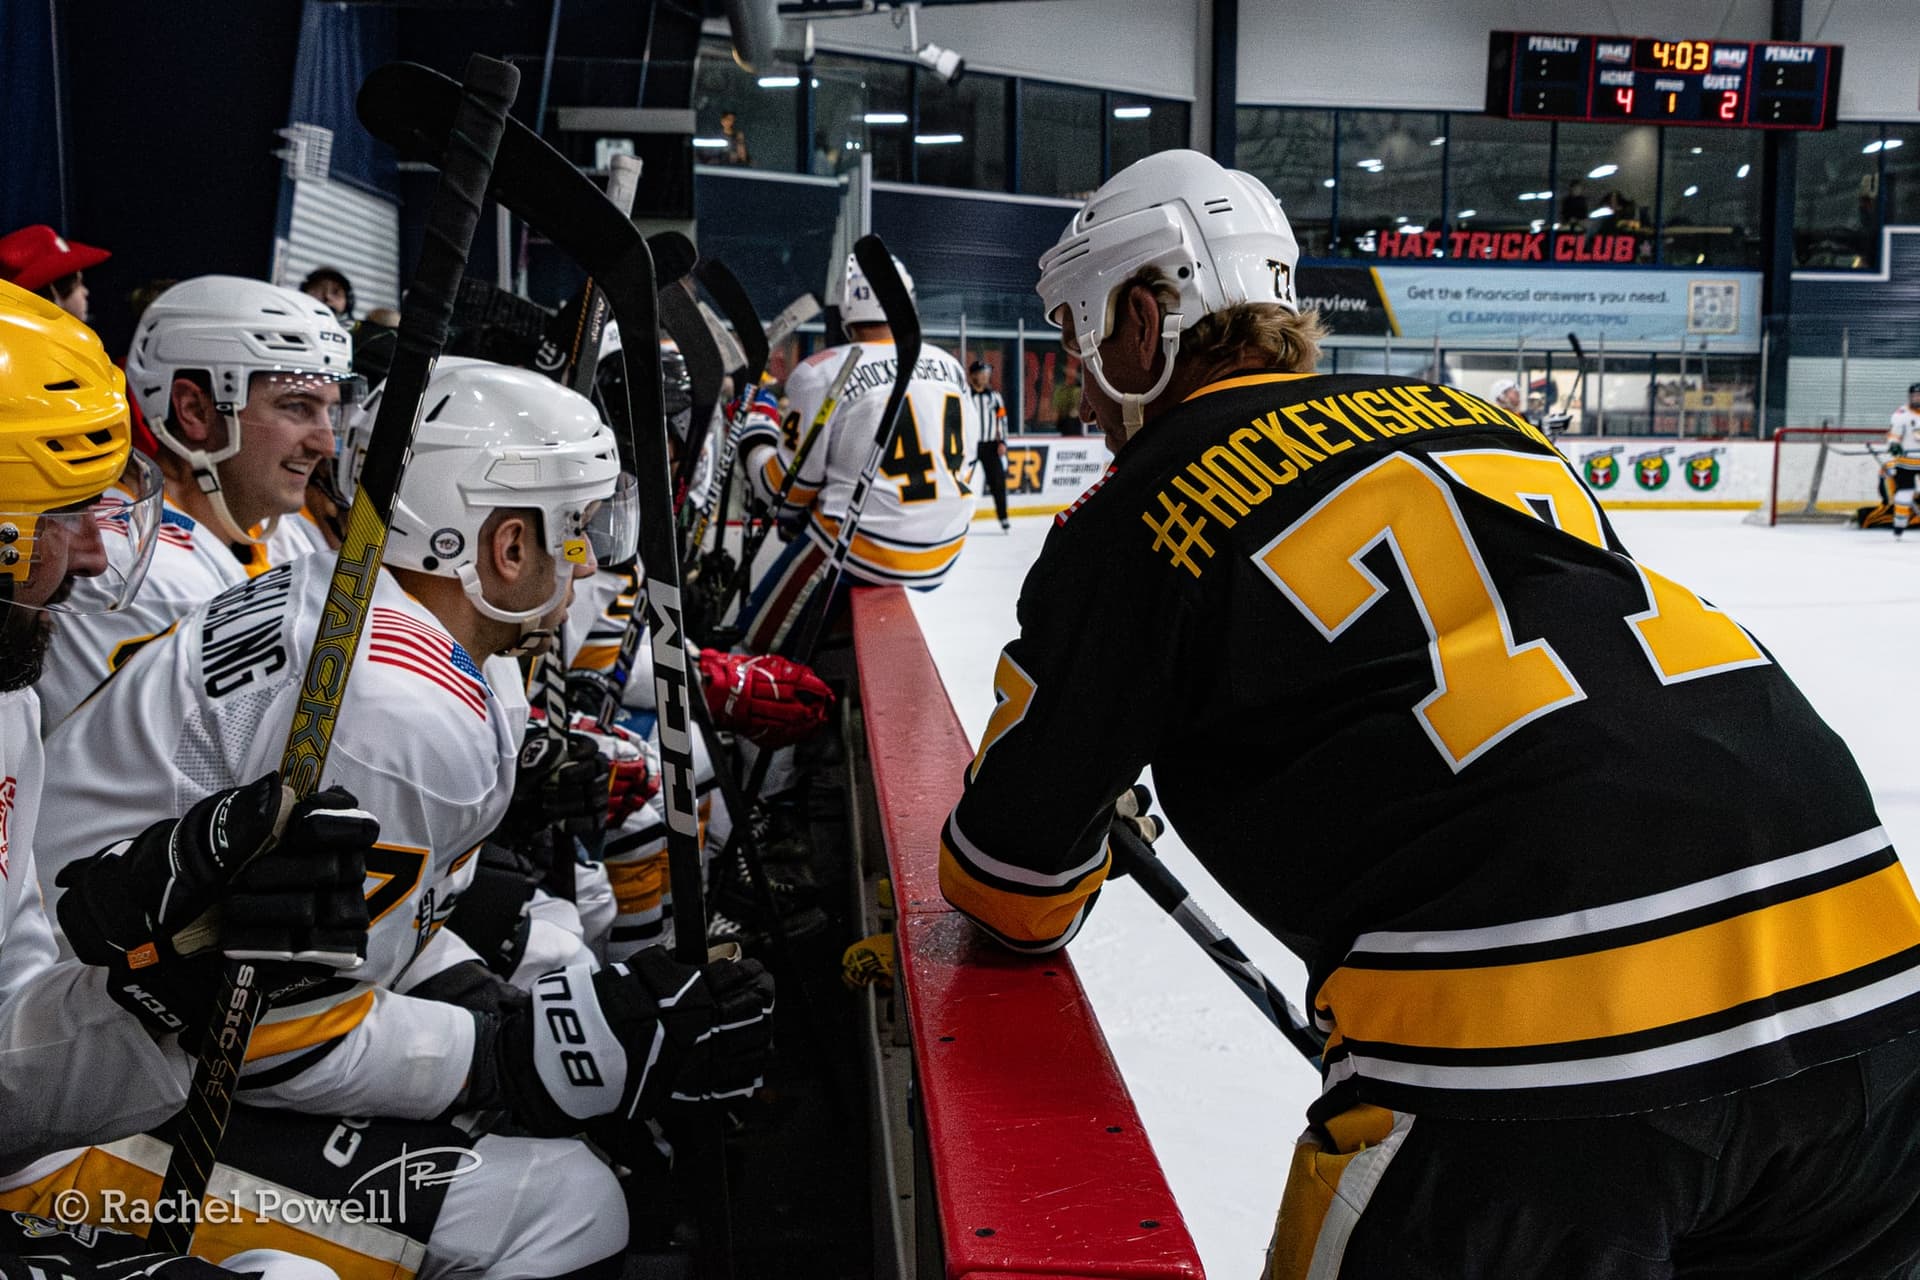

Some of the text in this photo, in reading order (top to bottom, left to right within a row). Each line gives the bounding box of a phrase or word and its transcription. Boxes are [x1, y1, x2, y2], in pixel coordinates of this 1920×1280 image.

[1528, 37, 1579, 53] PENALTY
[1653, 41, 1709, 71] 4:03
[1765, 46, 1814, 62] PENALTY
[1600, 70, 1635, 86] HOME
[1702, 74, 1741, 90] GUEST
[1616, 88, 1634, 114] 4
[1668, 92, 1677, 113] 1
[1720, 91, 1738, 119] 2
[1378, 230, 1636, 262] HAT TRICK CLUB
[1265, 258, 1292, 303] 77
[1407, 286, 1434, 300] Get
[1438, 287, 1462, 300] the
[1466, 288, 1530, 301] financial
[1533, 290, 1595, 302] answers
[1600, 292, 1626, 305] you
[1252, 450, 1773, 775] 77
[283, 544, 379, 800] TACKS
[647, 577, 698, 838] CCM
[537, 967, 605, 1087] BAU
